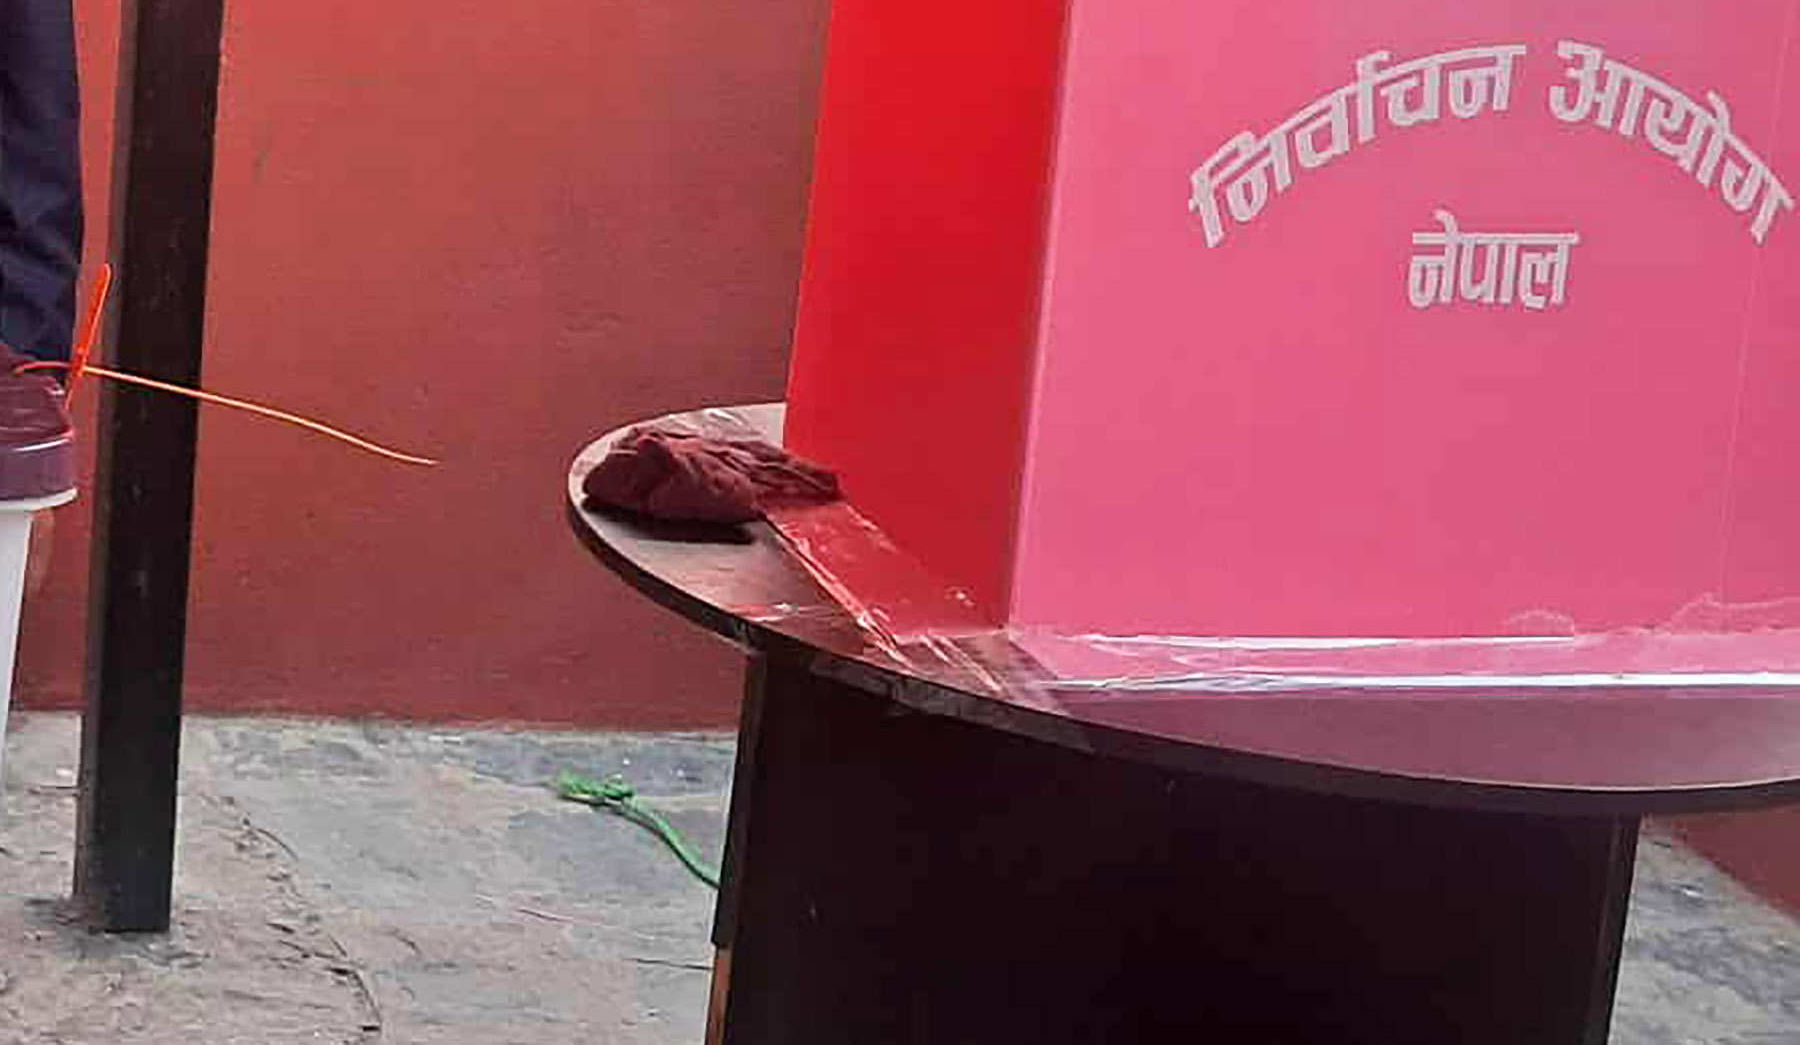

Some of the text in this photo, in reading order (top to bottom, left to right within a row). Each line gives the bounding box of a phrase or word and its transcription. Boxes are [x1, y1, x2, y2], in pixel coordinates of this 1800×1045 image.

[1189, 40, 1797, 249] निर्वाचन आयोग
[1407, 209, 1581, 311] नेपाल
